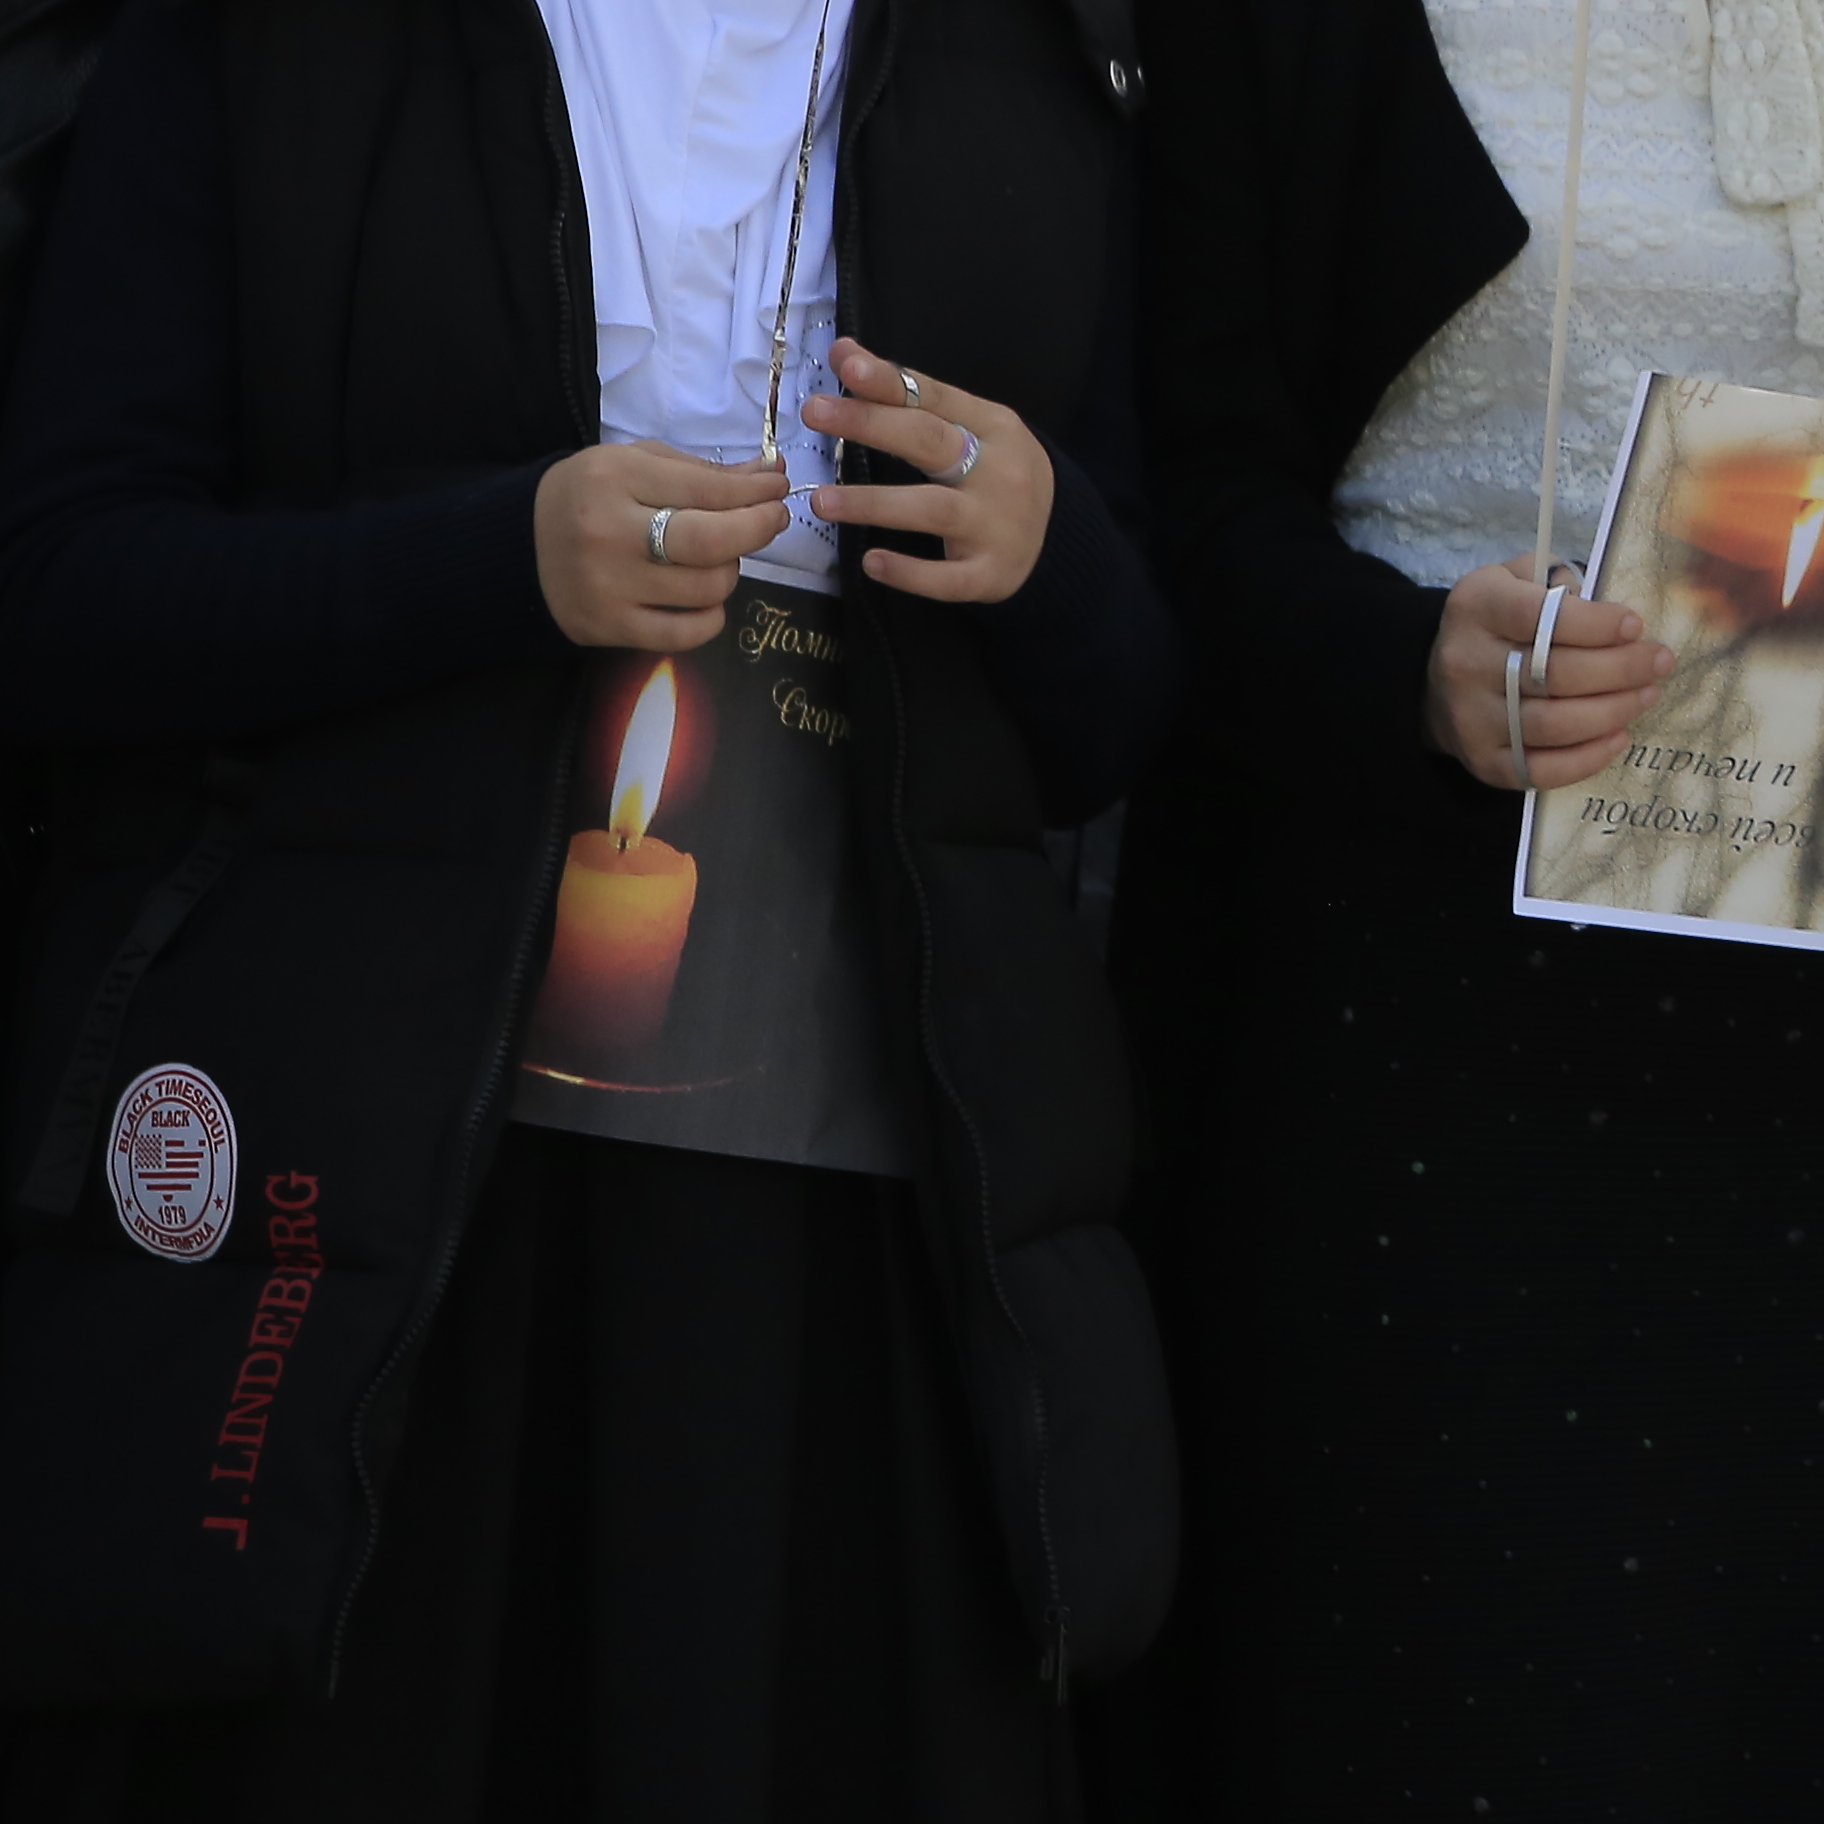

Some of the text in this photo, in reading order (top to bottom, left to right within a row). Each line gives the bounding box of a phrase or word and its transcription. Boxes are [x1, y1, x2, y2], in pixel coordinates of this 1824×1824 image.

[1623, 743, 1796, 789] и печали
[1580, 795, 1719, 843] скорби
[1730, 814, 1816, 854] всей
[118, 1079, 226, 1155] BLACK TIMESEOUL
[151, 1110, 190, 1128] BLACK
[158, 1205, 187, 1226] 1979
